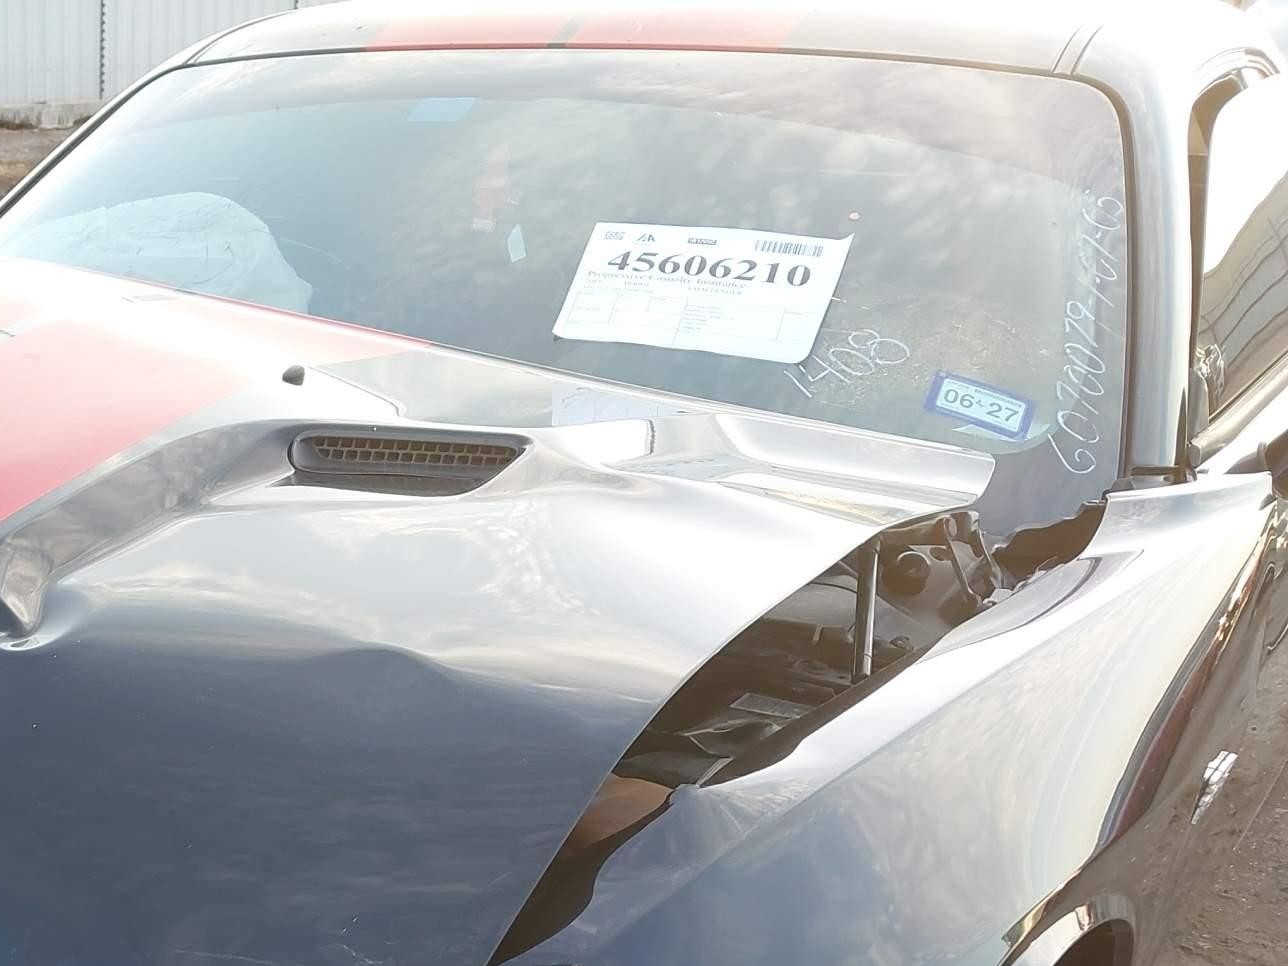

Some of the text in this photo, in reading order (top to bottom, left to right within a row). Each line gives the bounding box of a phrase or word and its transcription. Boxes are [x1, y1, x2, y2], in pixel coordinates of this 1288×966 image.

[607, 250, 811, 287] 45606210
[943, 388, 975, 409] 06
[985, 402, 1020, 422] 27
